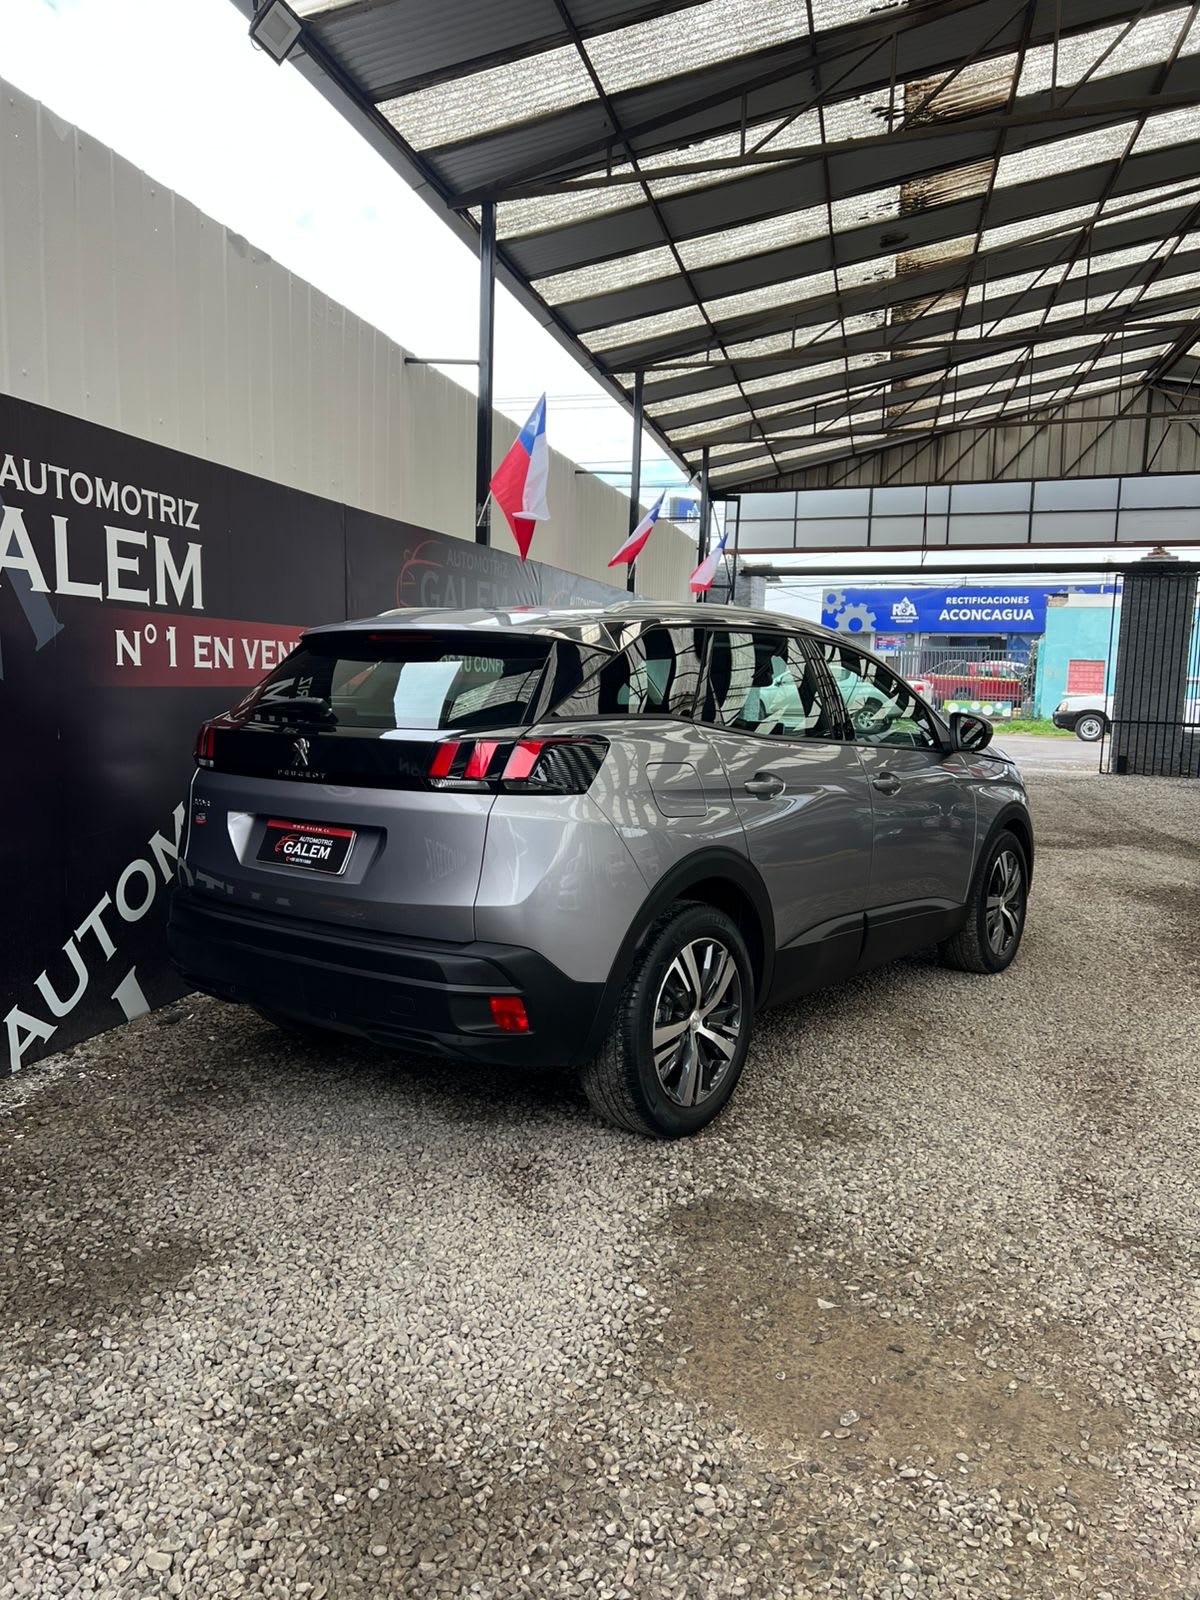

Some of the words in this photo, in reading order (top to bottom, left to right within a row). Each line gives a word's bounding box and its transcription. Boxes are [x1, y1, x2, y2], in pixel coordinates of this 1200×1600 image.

[0, 453, 200, 530] AUTOMOTRIZ
[945, 596, 1030, 605] RECTIFICACIONES
[939, 609, 1035, 621] ACONCAGUA
[193, 636, 234, 669] EN
[299, 836, 334, 847] AUTOMOTRIZ
[283, 841, 331, 860] GALEM
